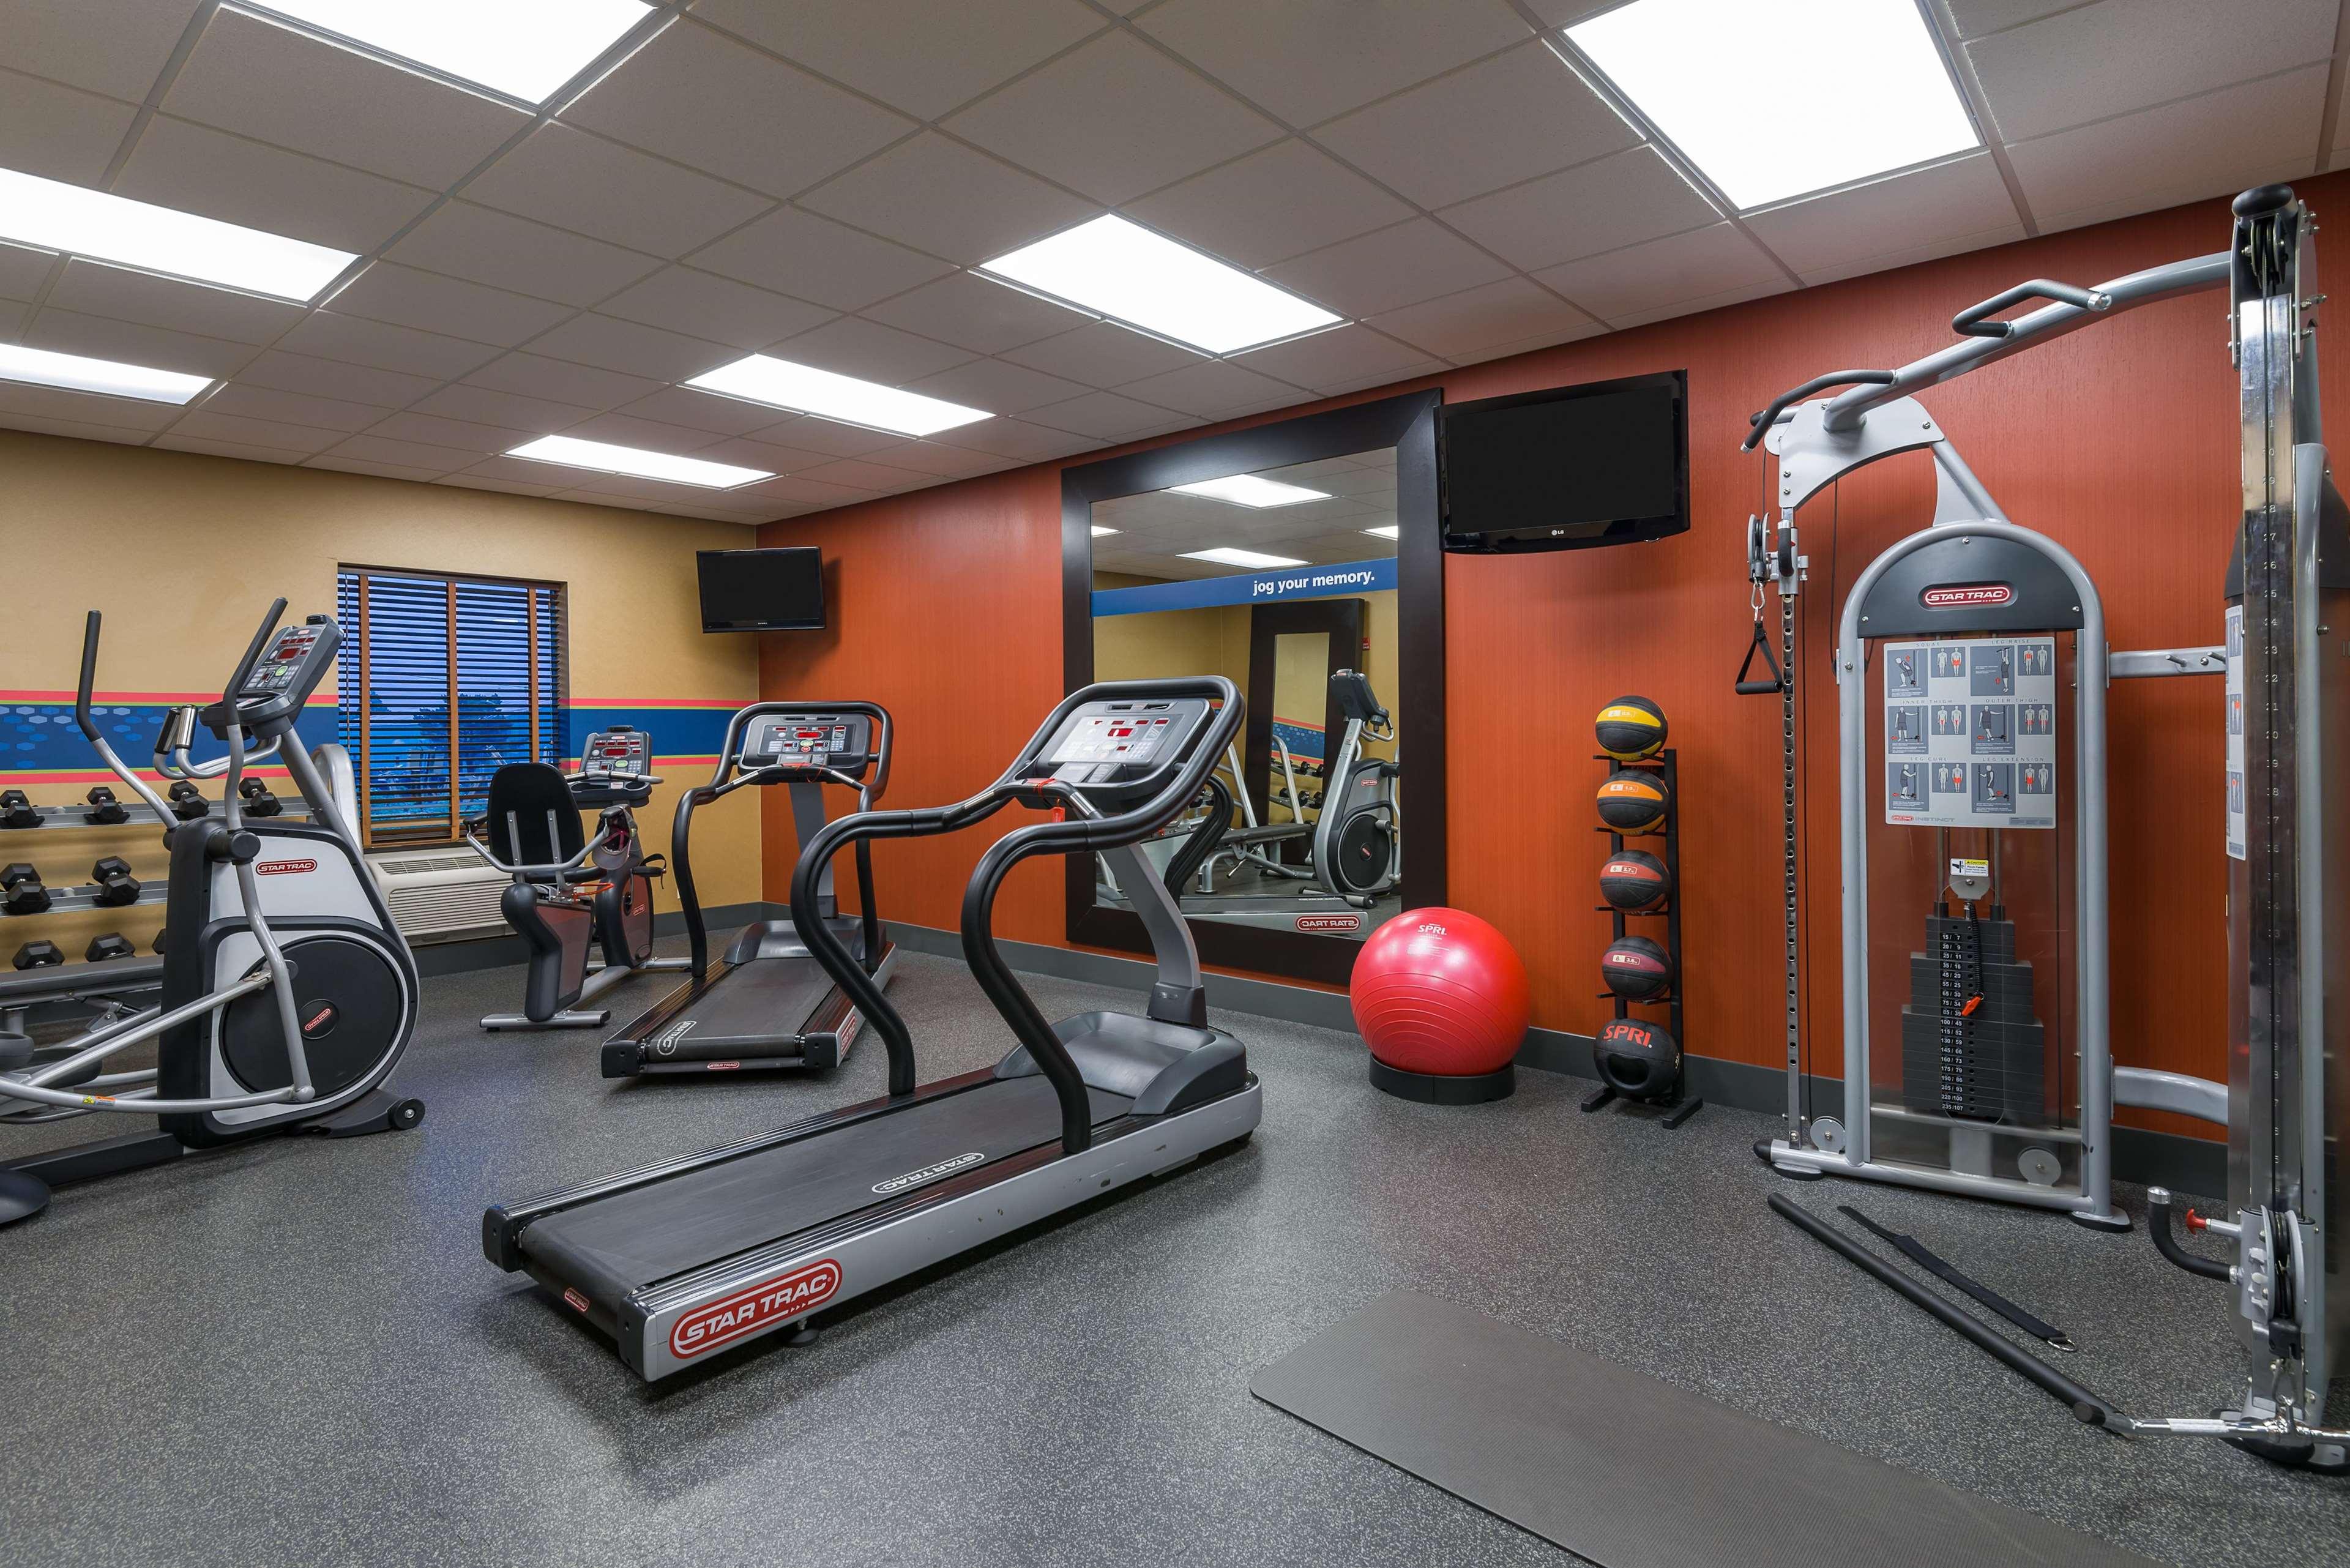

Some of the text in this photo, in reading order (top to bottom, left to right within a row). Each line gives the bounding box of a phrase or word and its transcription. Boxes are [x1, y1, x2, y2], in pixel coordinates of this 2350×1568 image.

[1253, 571, 1375, 596] jog your memory.
[1417, 925, 1446, 936] SPRI
[1603, 1025, 1651, 1048] SPRI
[881, 1155, 977, 1190] STAR TRAC
[687, 1273, 828, 1338] STAR TRAC
